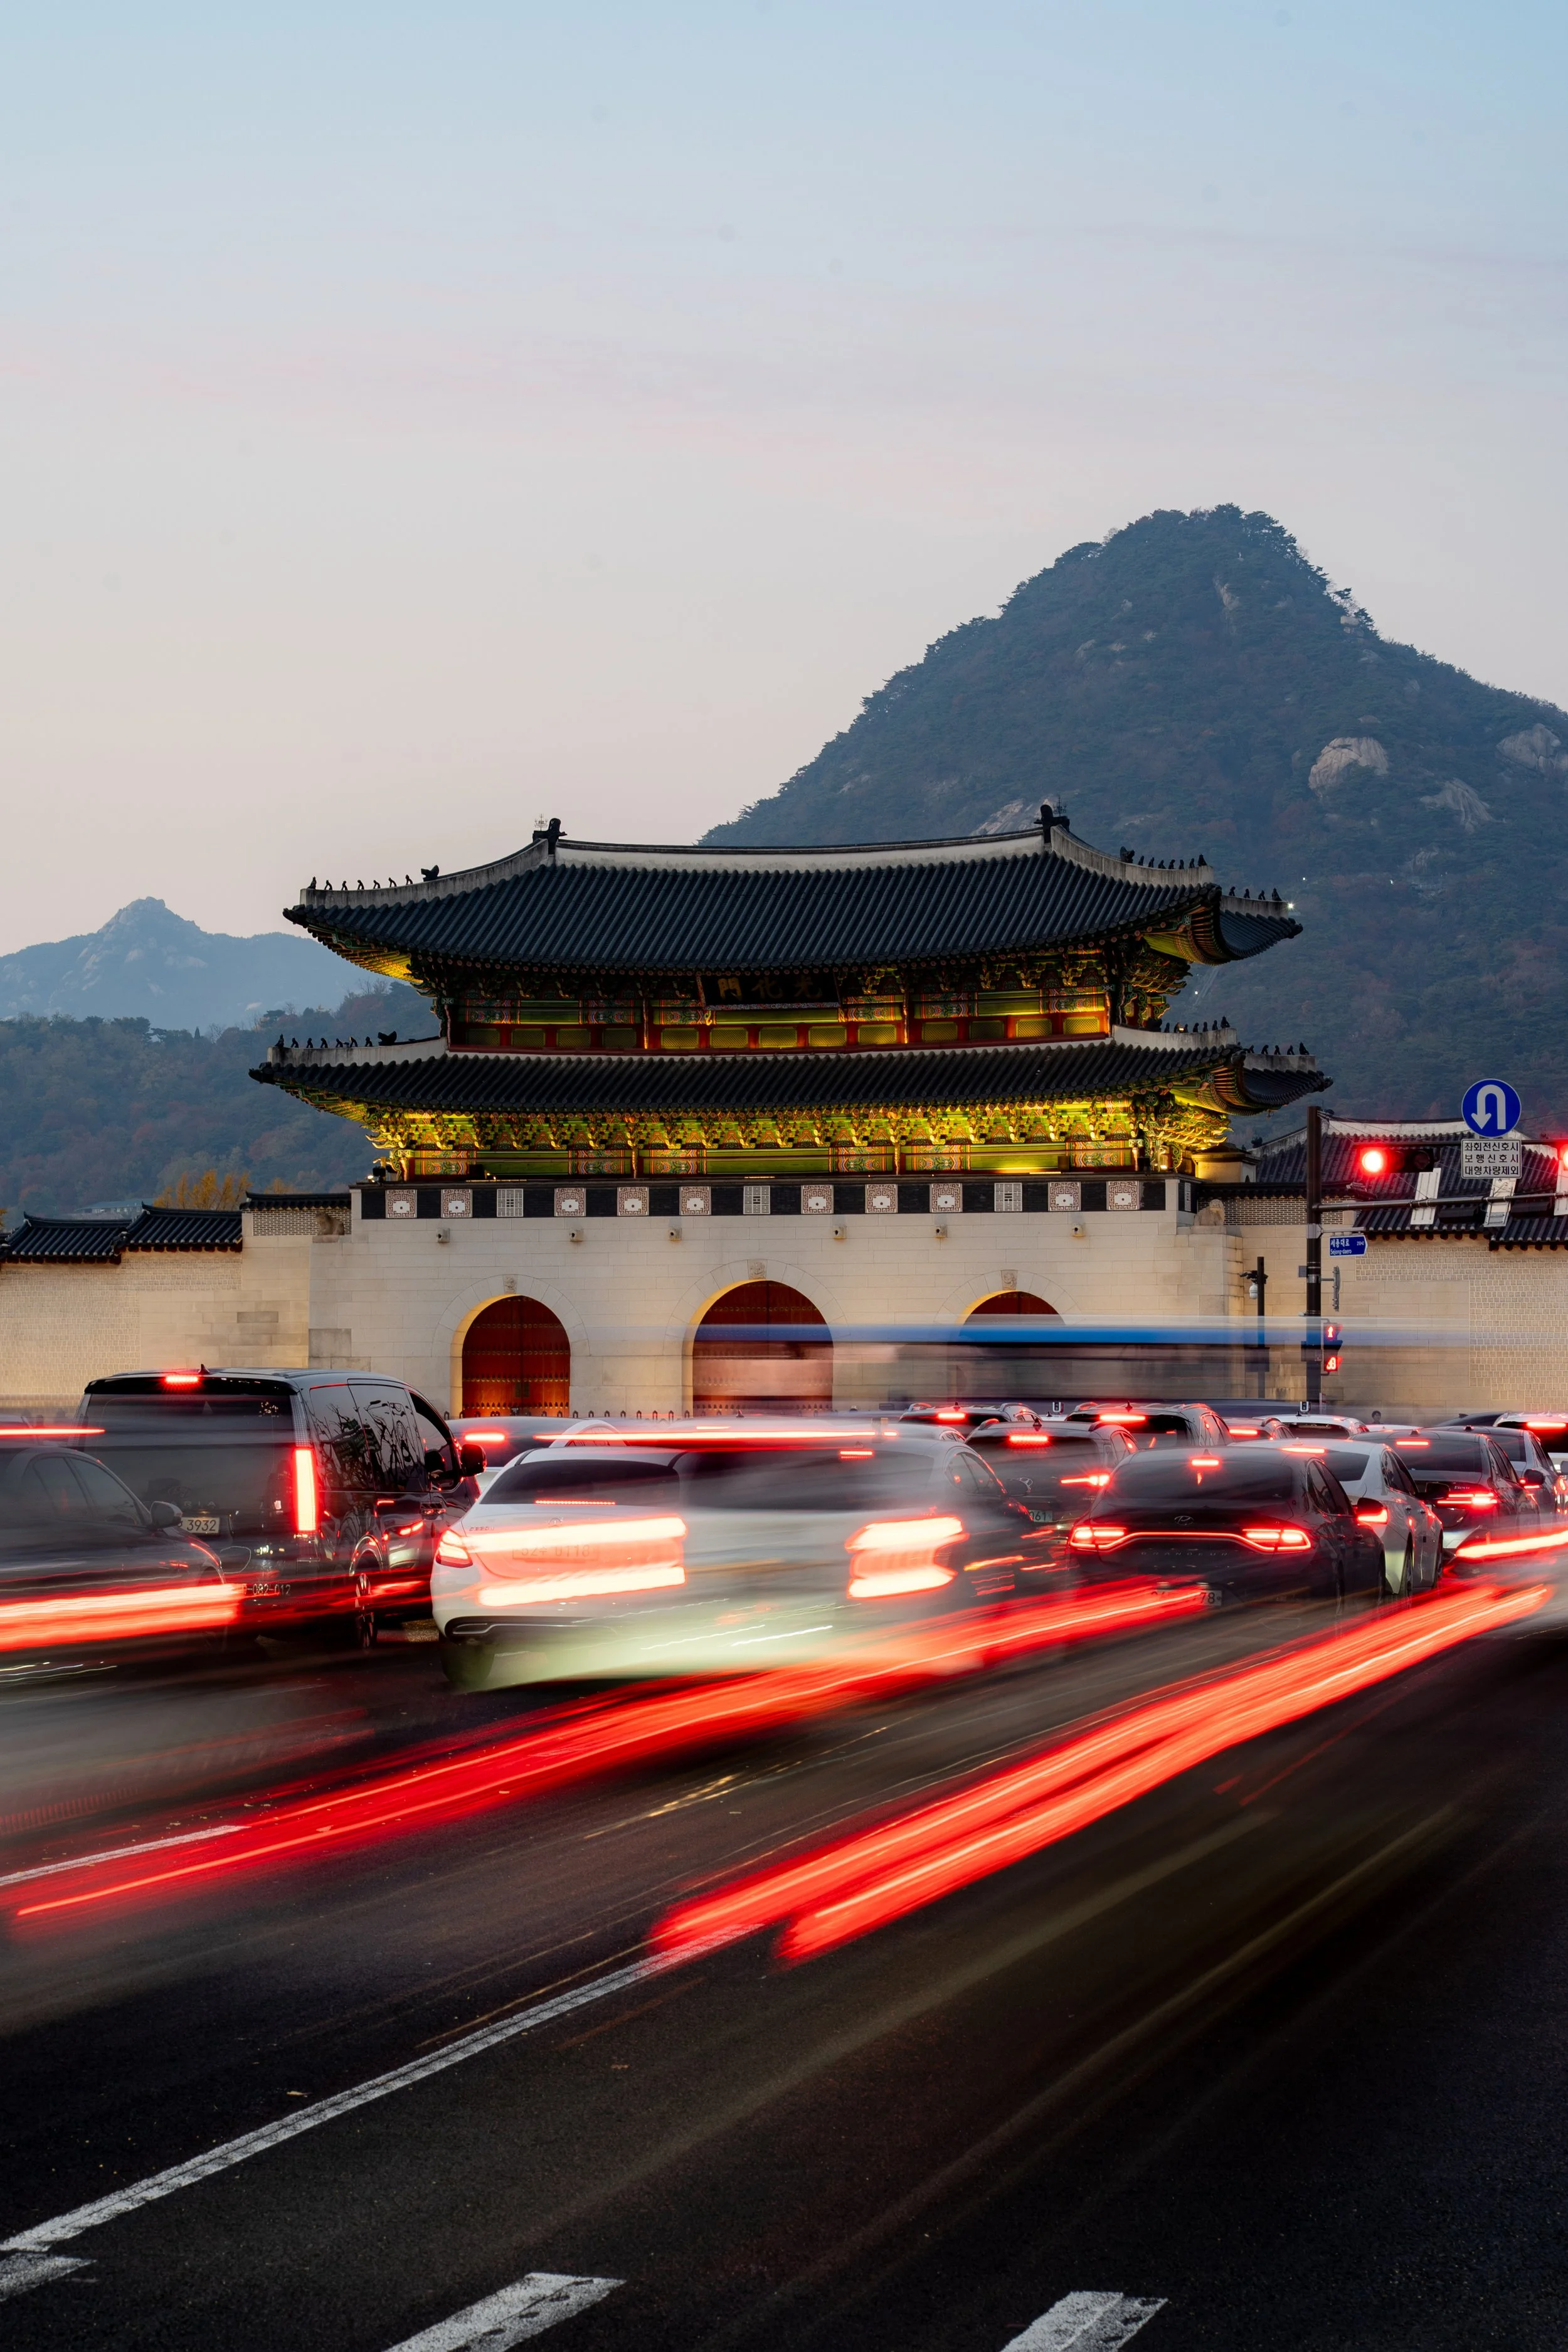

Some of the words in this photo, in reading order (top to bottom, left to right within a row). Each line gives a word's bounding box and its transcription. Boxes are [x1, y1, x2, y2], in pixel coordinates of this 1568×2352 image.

[1465, 1142, 1518, 1152] 좌회전신호시
[1465, 1166, 1518, 1175] 대형차량제외
[1331, 1239, 1350, 1248] 세종대로
[186, 1519, 216, 1532] 3932
